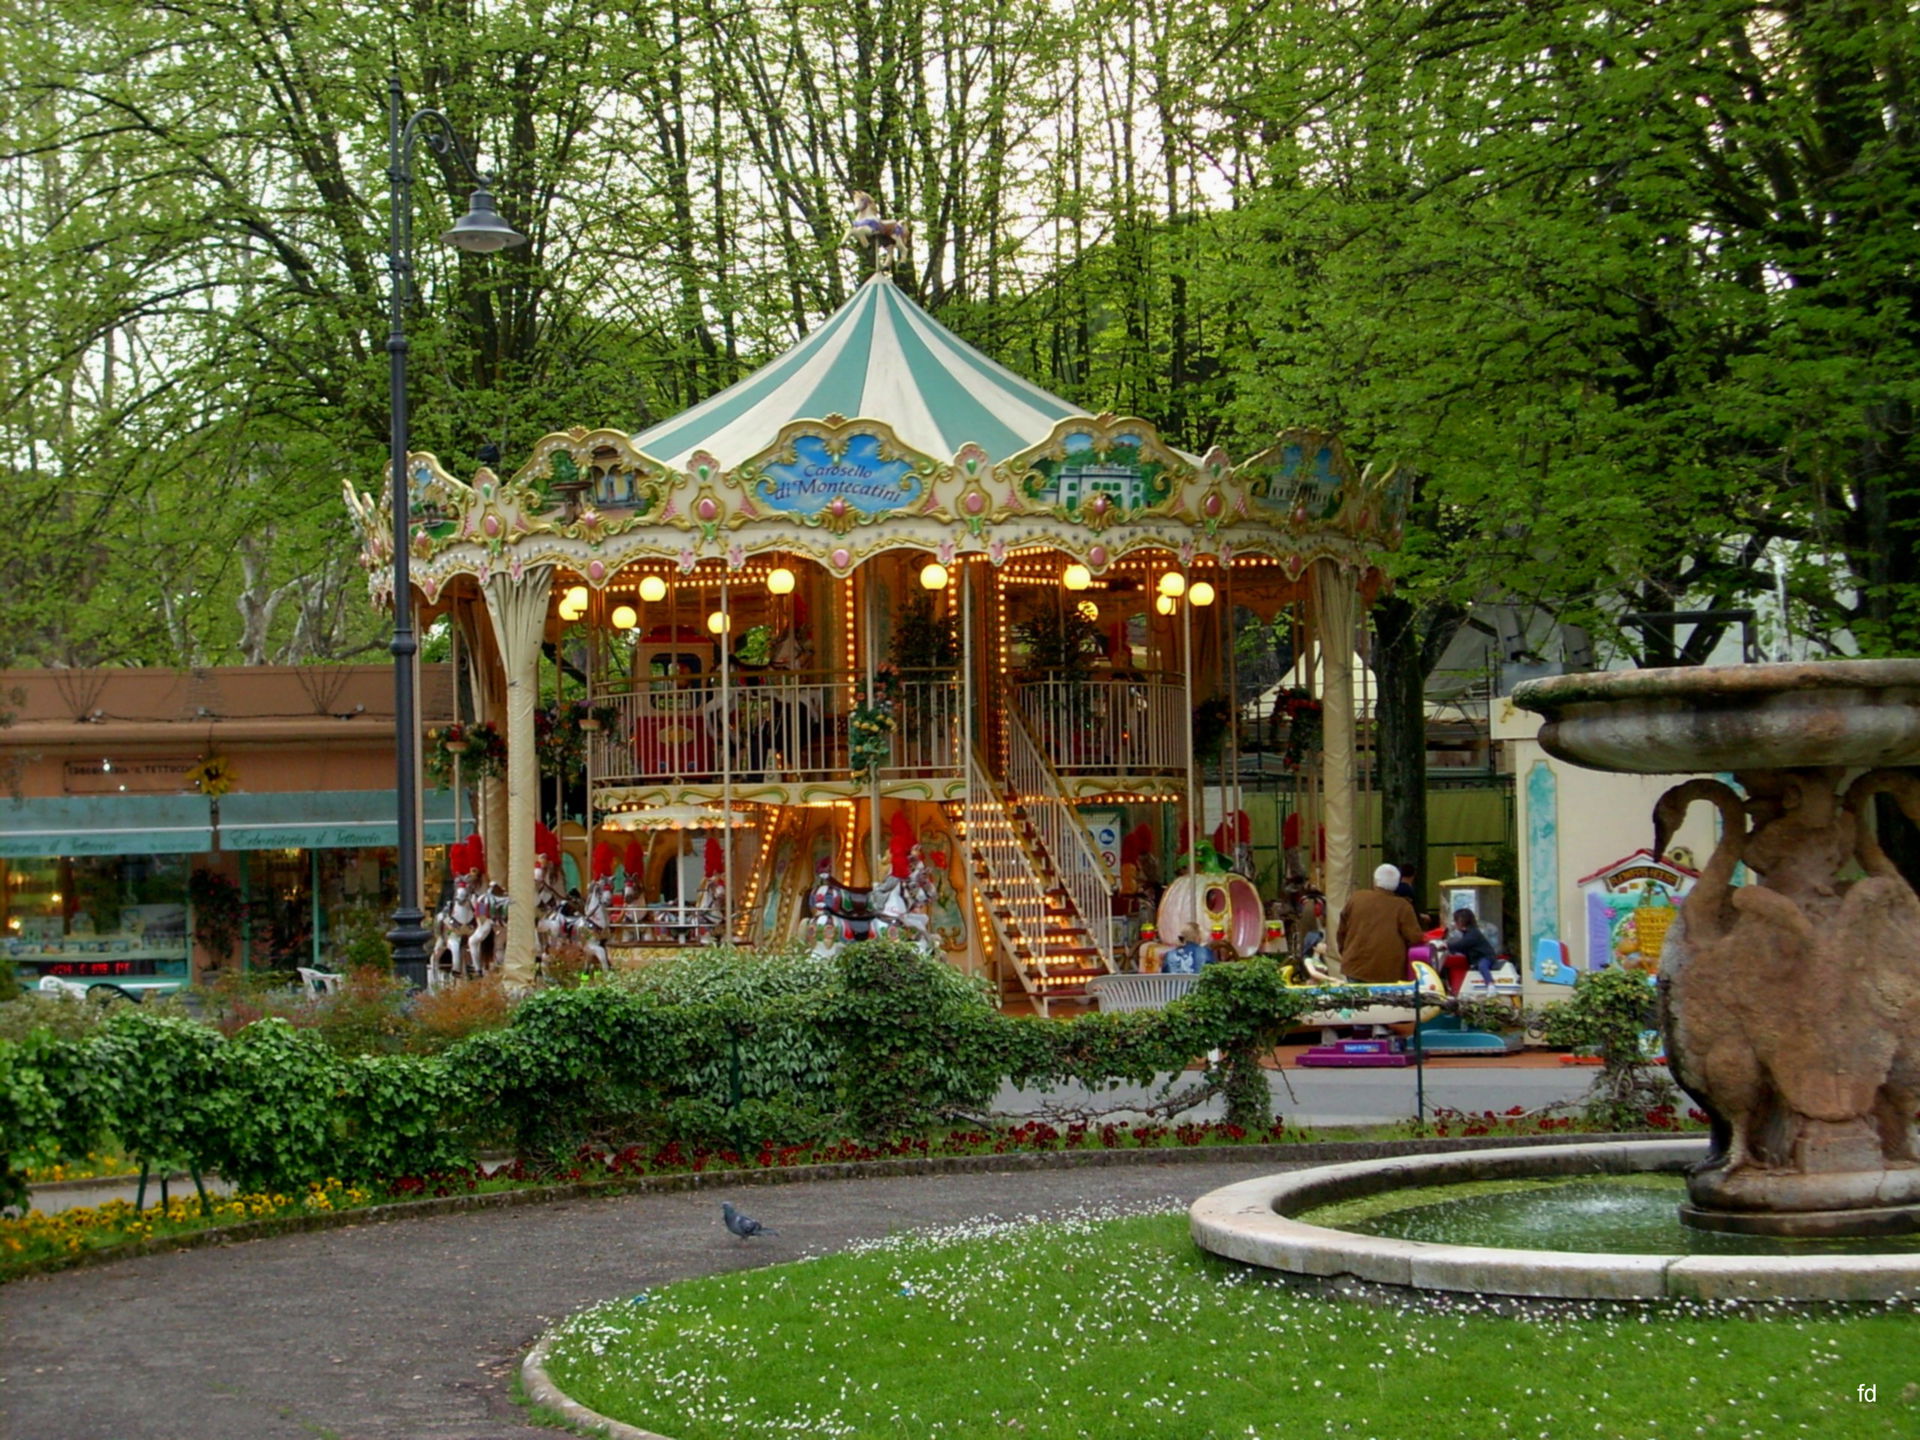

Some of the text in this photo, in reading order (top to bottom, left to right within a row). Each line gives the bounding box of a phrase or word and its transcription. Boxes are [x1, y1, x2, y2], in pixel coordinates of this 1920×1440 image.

[803, 463, 873, 478] Carosello
[775, 478, 901, 503] di Montecatini
